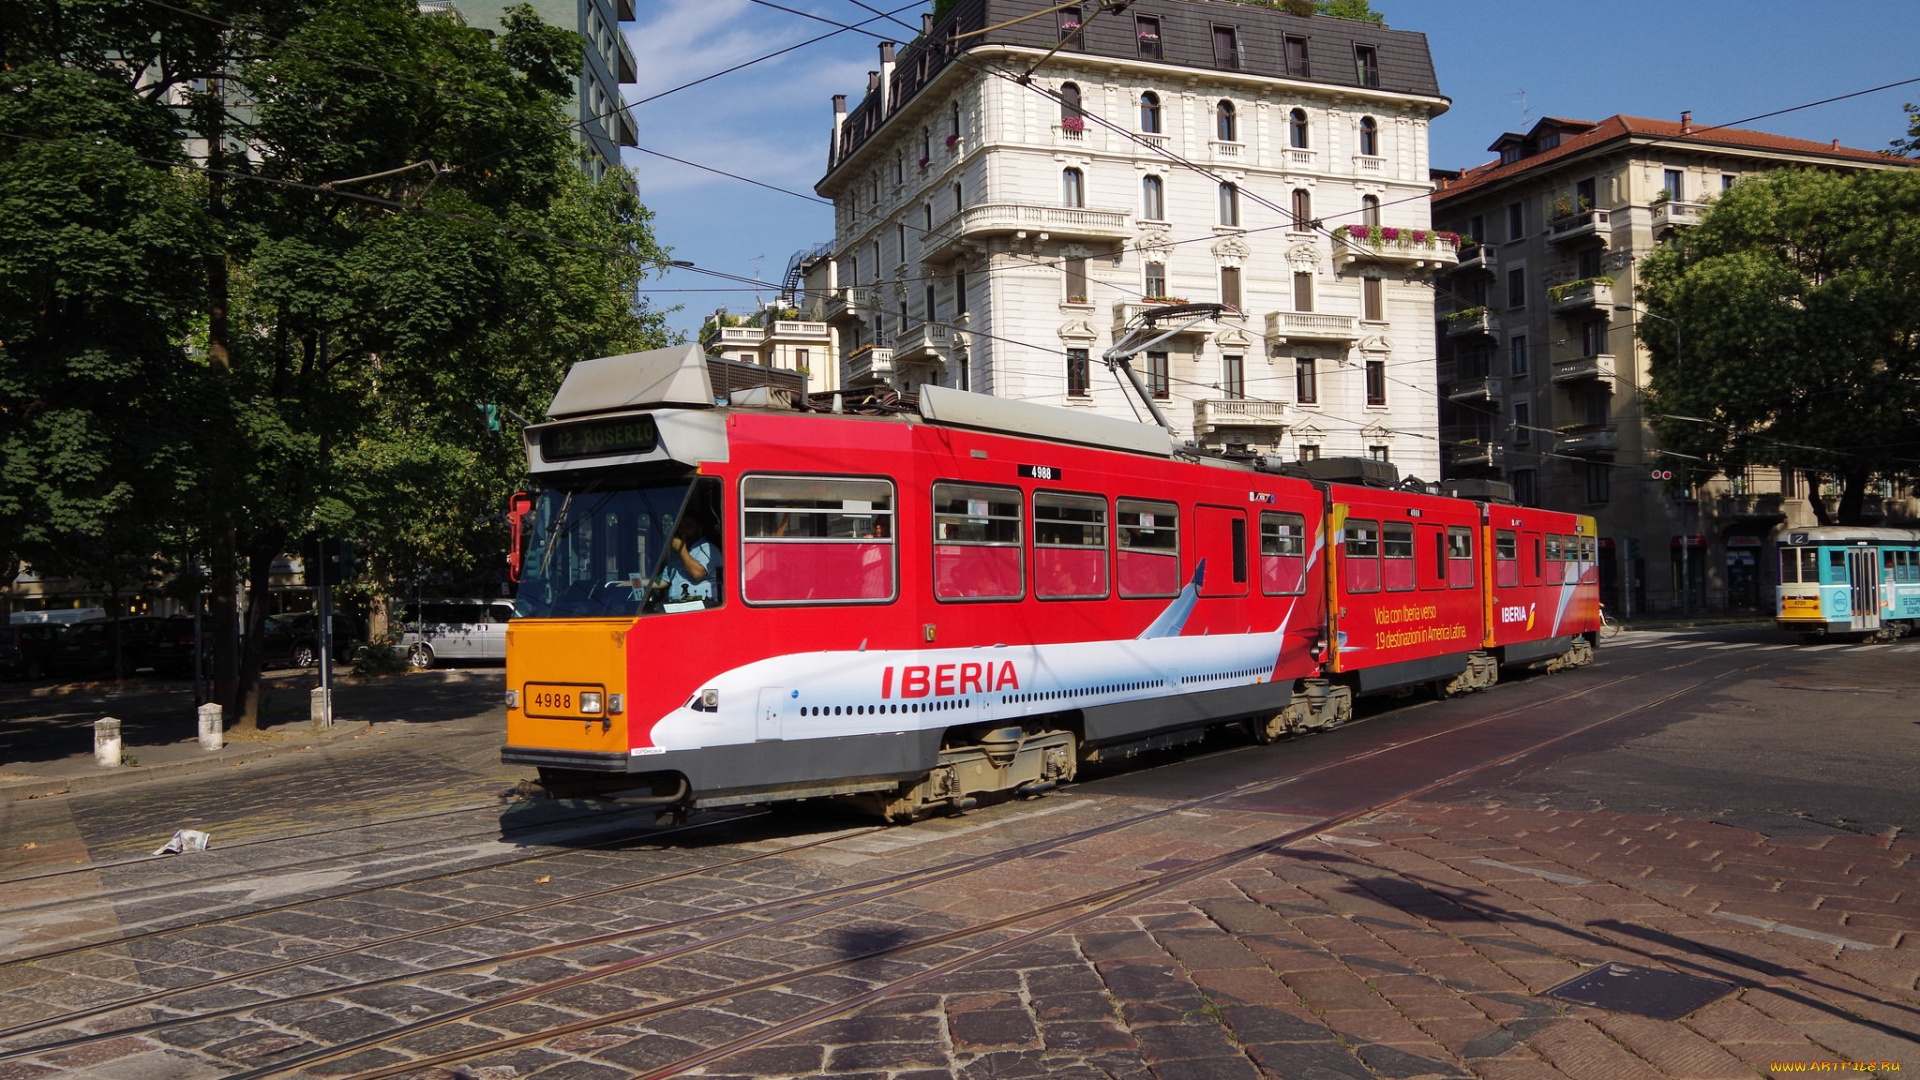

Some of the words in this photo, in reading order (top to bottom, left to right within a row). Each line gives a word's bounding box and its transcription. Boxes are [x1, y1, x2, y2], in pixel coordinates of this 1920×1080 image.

[557, 433, 575, 451] 12
[584, 423, 654, 448] ROSERIO
[1032, 465, 1051, 480] 4988
[1795, 535, 1803, 544] 2
[1374, 606, 1389, 625] Vola
[1390, 609, 1402, 624] con
[1403, 604, 1420, 622] Iberia
[1421, 606, 1437, 620] verso
[1501, 606, 1527, 623] IBERIA
[1376, 632, 1385, 650] 19
[1386, 628, 1420, 649] destinazioni
[1420, 626, 1428, 643] in
[1428, 624, 1449, 642] America
[881, 660, 1020, 699] IBERIA
[535, 693, 571, 709] 4988
